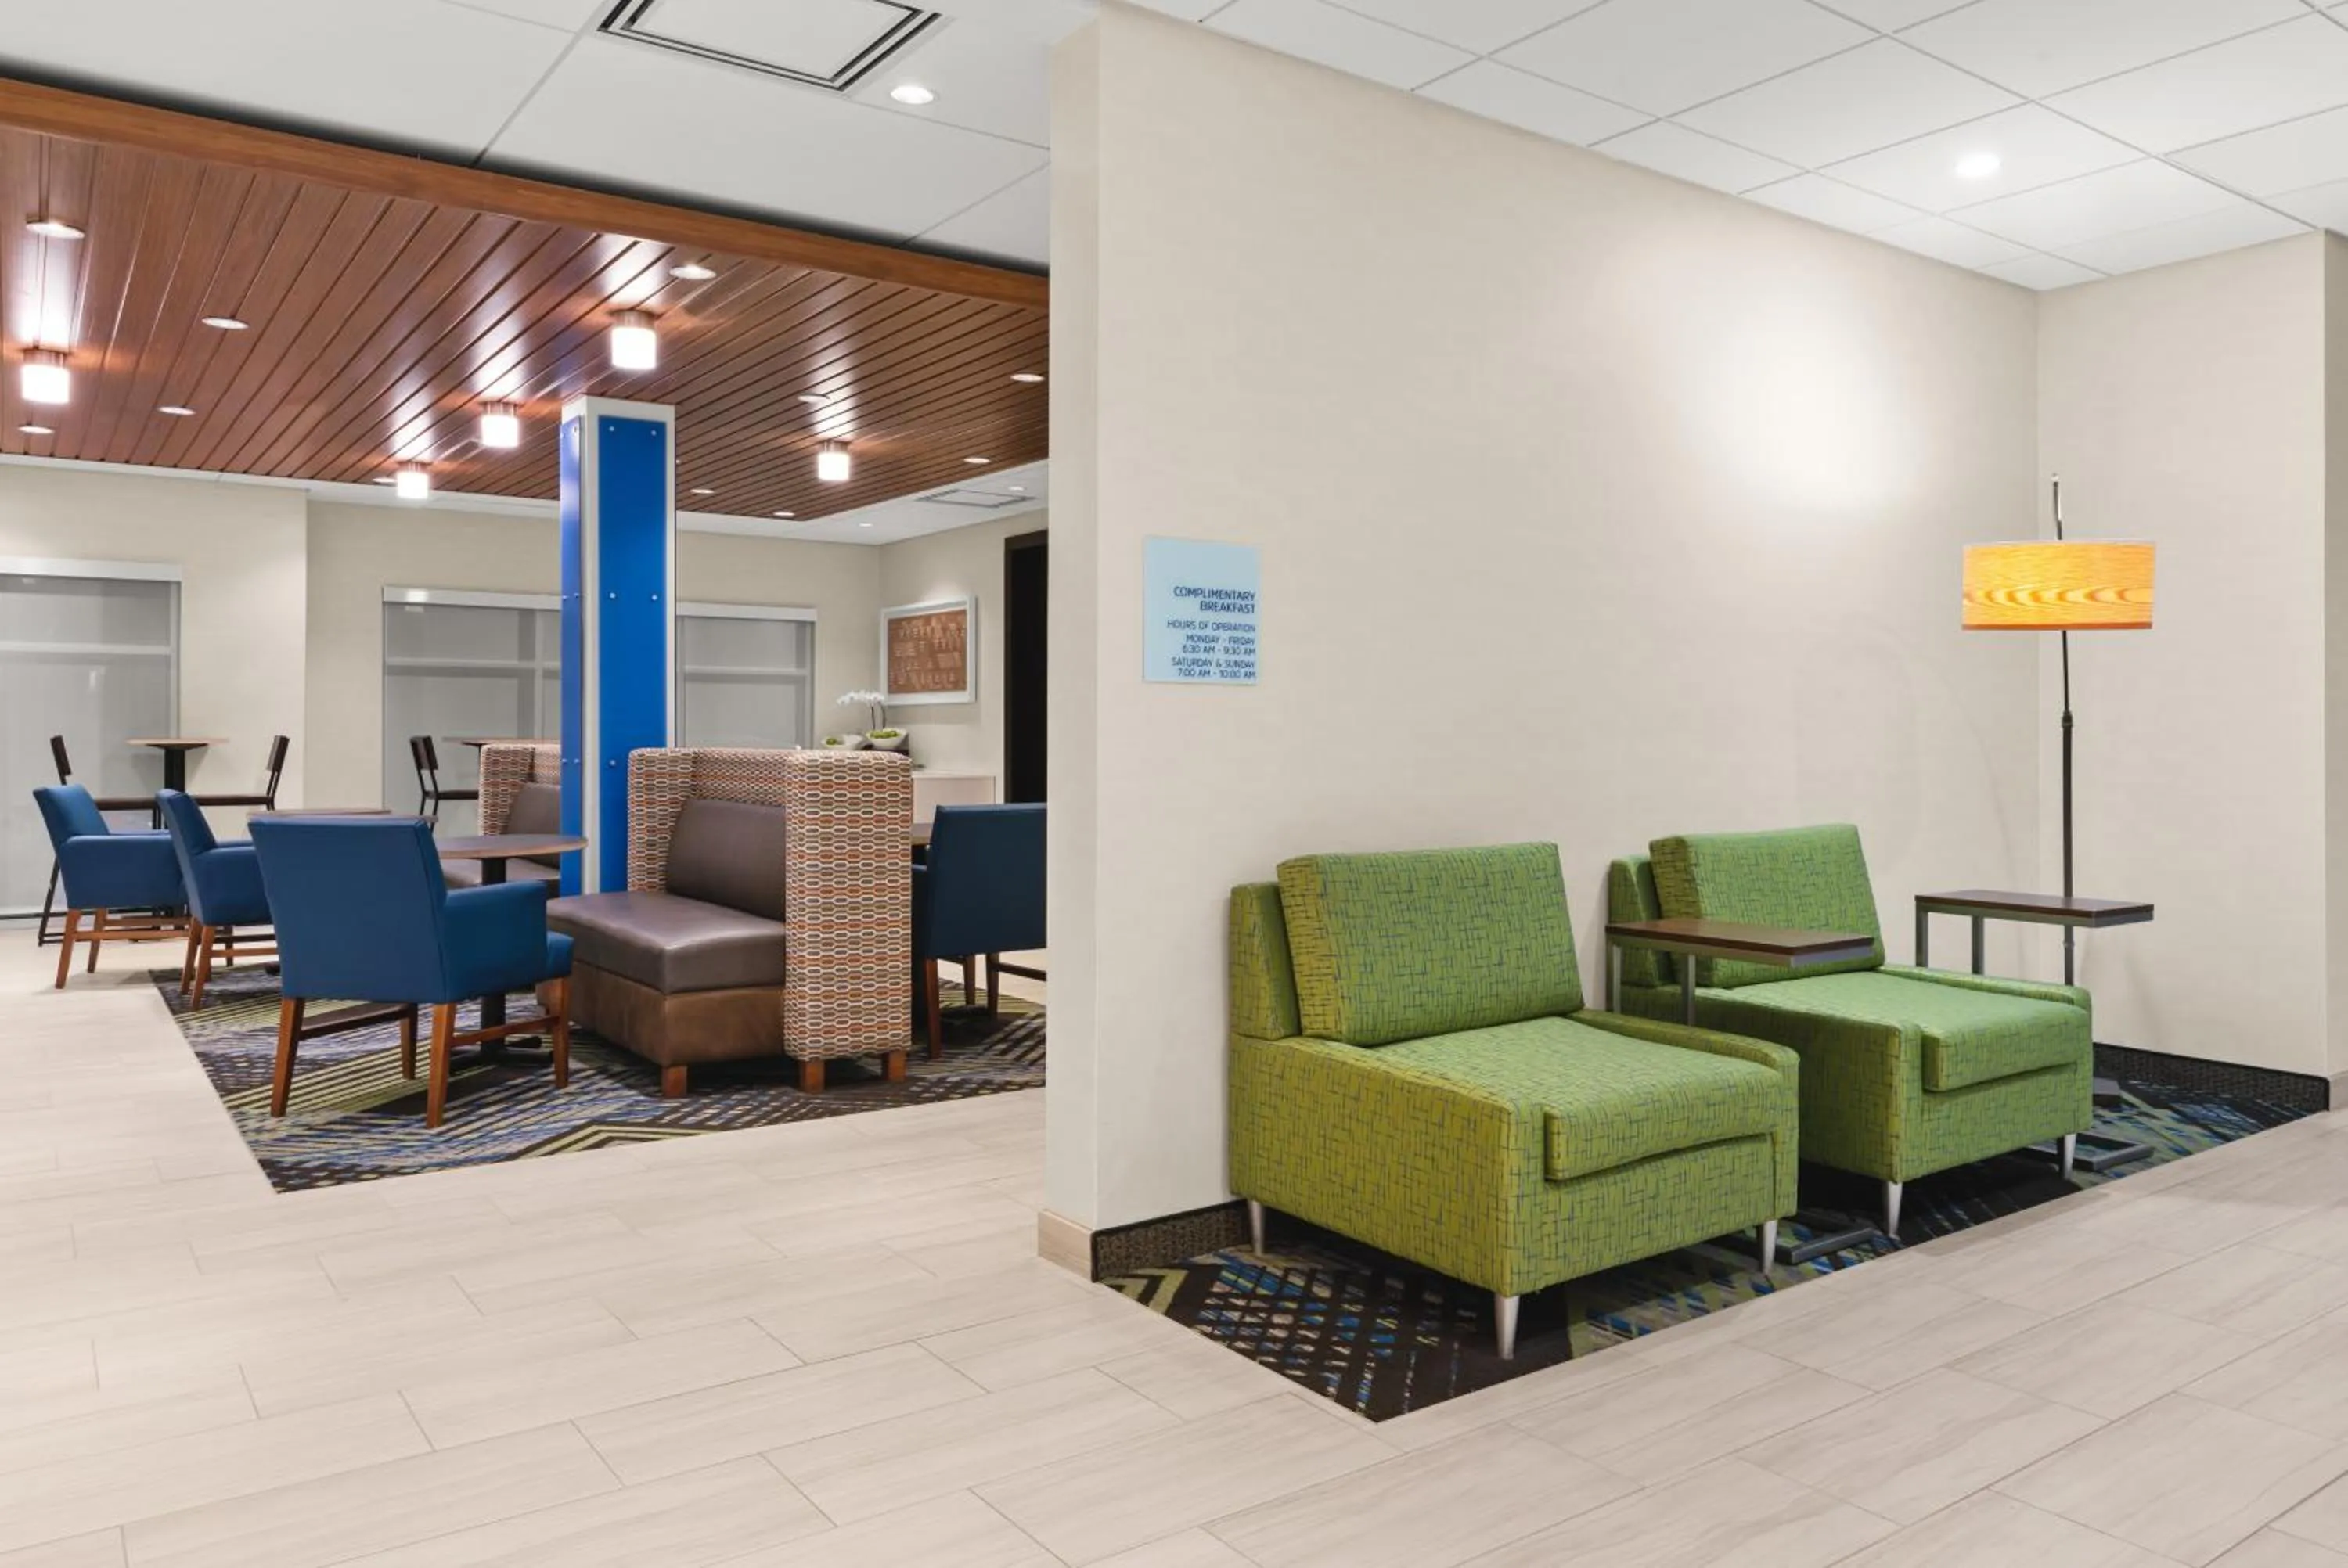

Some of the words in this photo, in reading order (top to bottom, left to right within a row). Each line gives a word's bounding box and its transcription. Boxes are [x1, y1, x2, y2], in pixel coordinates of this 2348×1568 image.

[1174, 587, 1255, 601] COMPLIMENTARY
[1200, 601, 1255, 613] BREAKFAST
[1167, 620, 1196, 629] HOURS
[1186, 635, 1219, 643] MONDAY
[1244, 647, 1255, 656] AM
[1172, 657, 1212, 667] SATURDAY
[1226, 660, 1255, 668] SUNDAY
